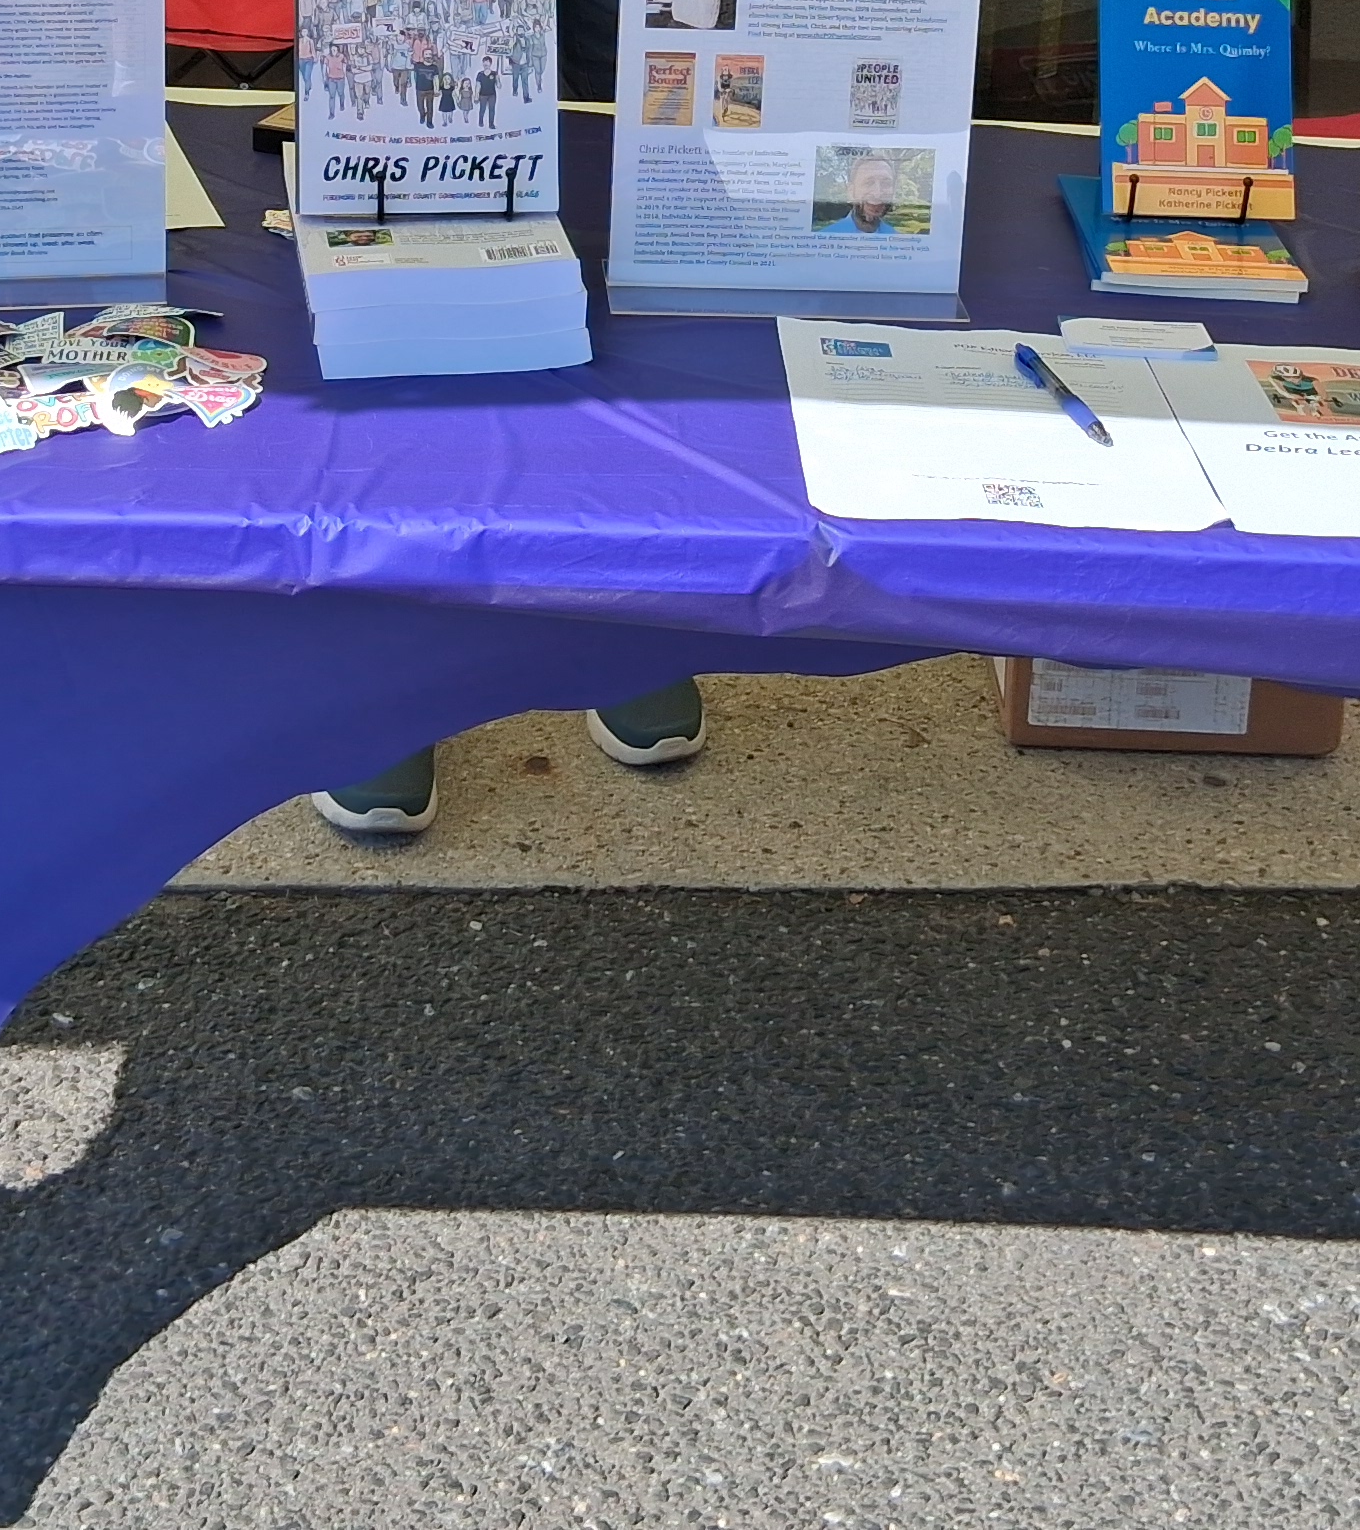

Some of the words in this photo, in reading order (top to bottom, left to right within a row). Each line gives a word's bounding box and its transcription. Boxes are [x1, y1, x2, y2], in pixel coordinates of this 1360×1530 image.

[1143, 7, 1262, 35] Academy
[1134, 40, 1172, 53] Where
[1176, 42, 1187, 54] Is
[1190, 43, 1216, 55] Mrs.
[1220, 44, 1271, 59] Quimby?
[648, 64, 692, 76] Perfect
[861, 64, 899, 74] PEOPLE
[648, 74, 687, 85] Bound
[856, 74, 899, 84] UNITED
[639, 144, 665, 154] Chris
[668, 145, 702, 155] Pickett
[1168, 188, 1201, 197] Nancy
[1158, 199, 1212, 209] Katherine
[50, 338, 86, 349] LOVE
[89, 339, 128, 348] YOUR
[47, 349, 128, 362] MOTHER
[184, 389, 240, 408] Drag
[1263, 430, 1298, 440] Get
[1304, 432, 1338, 441] the
[1246, 443, 1318, 455] Debra
